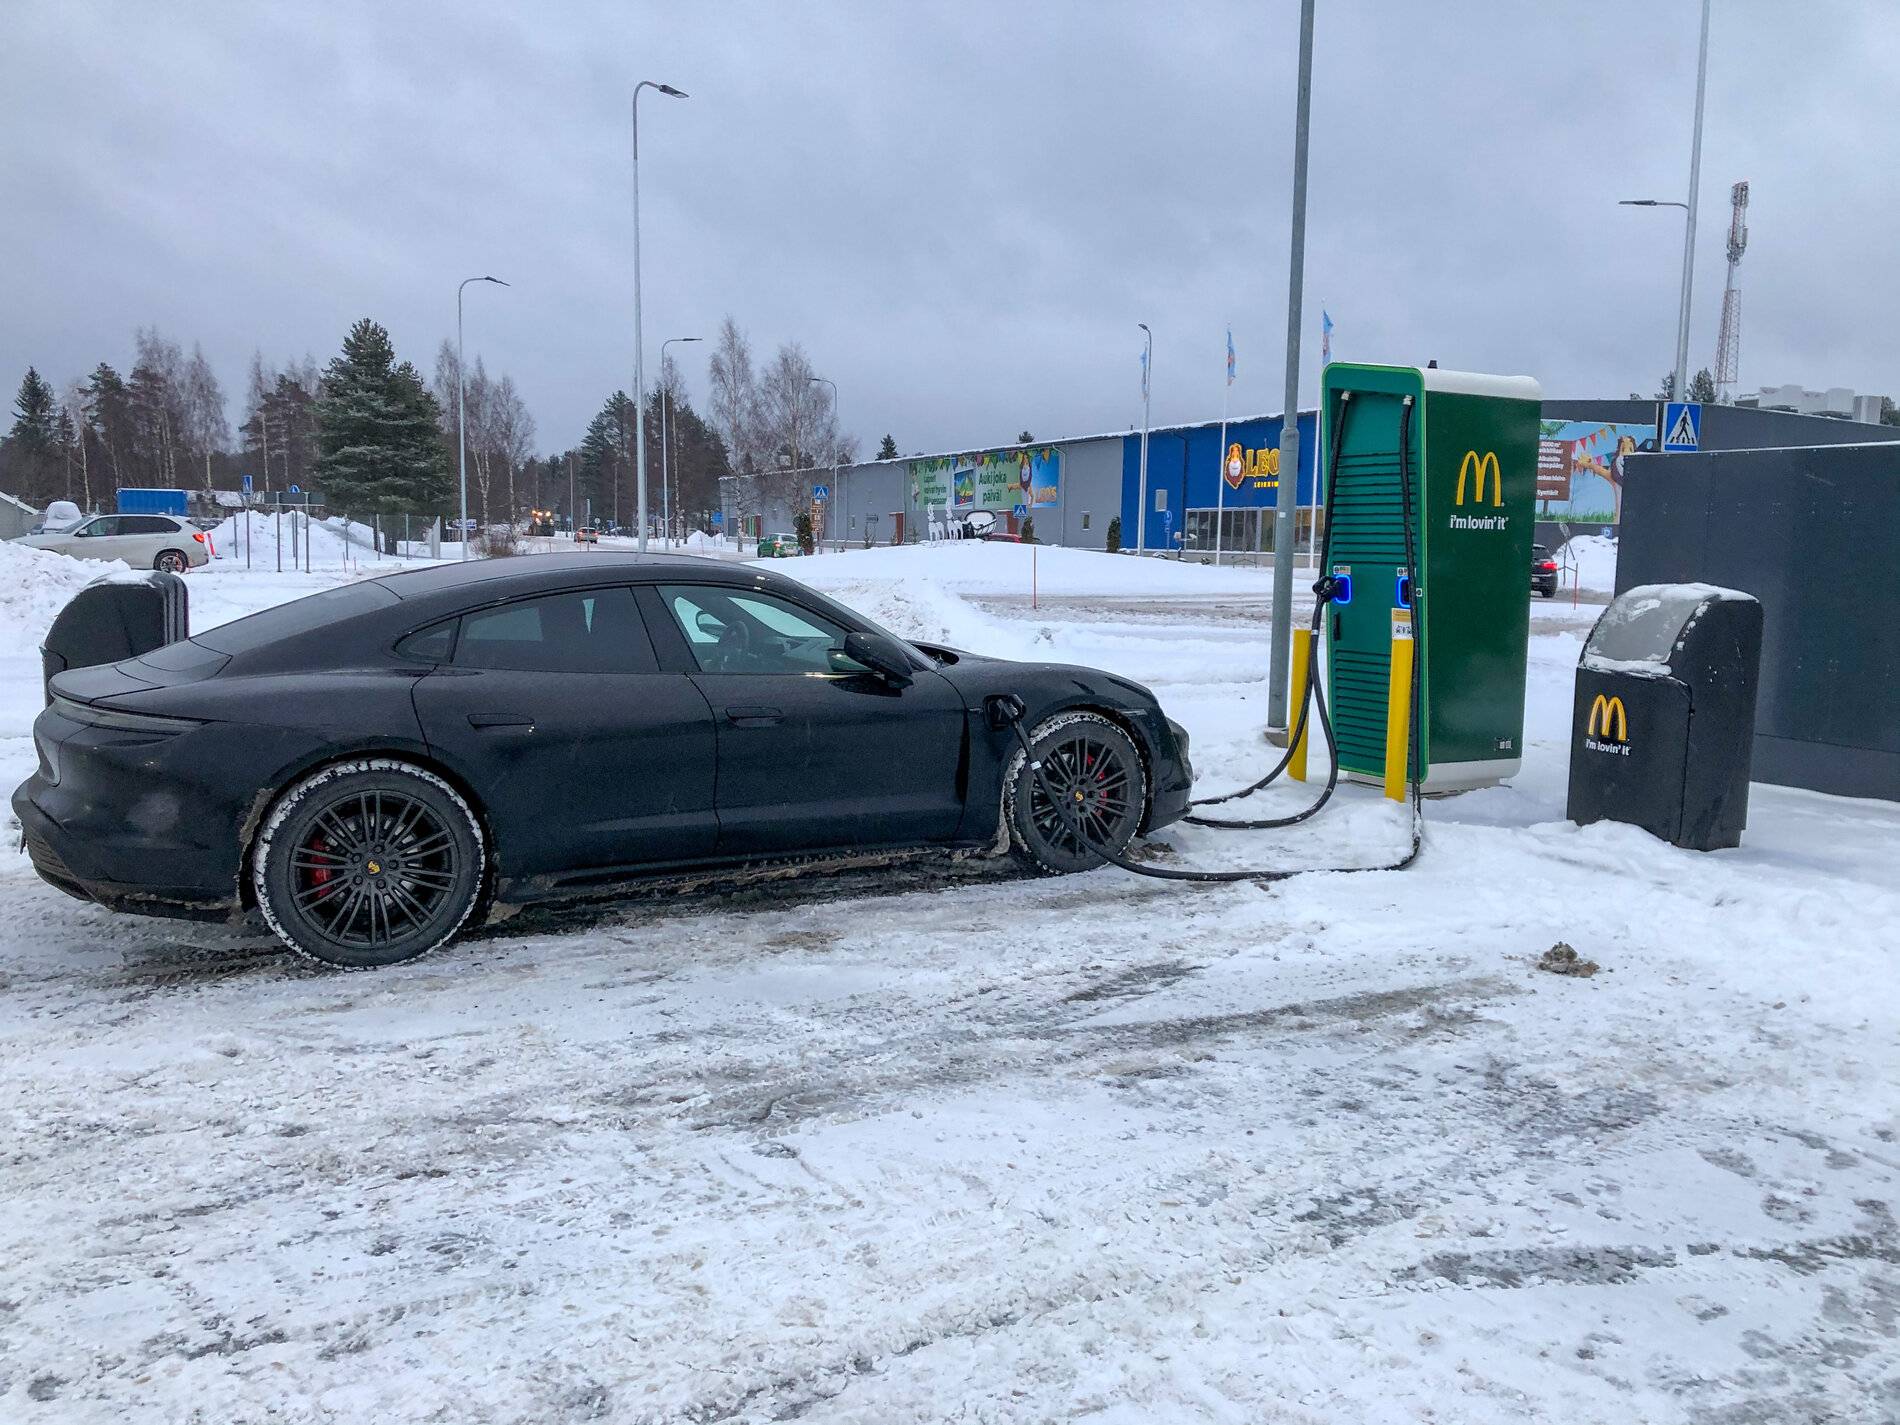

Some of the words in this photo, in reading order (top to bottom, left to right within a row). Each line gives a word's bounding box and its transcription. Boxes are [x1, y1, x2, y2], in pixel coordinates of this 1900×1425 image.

[1450, 514, 1467, 529] i'm
[1467, 514, 1497, 530] lovin'
[1597, 741, 1621, 754] lovin'
